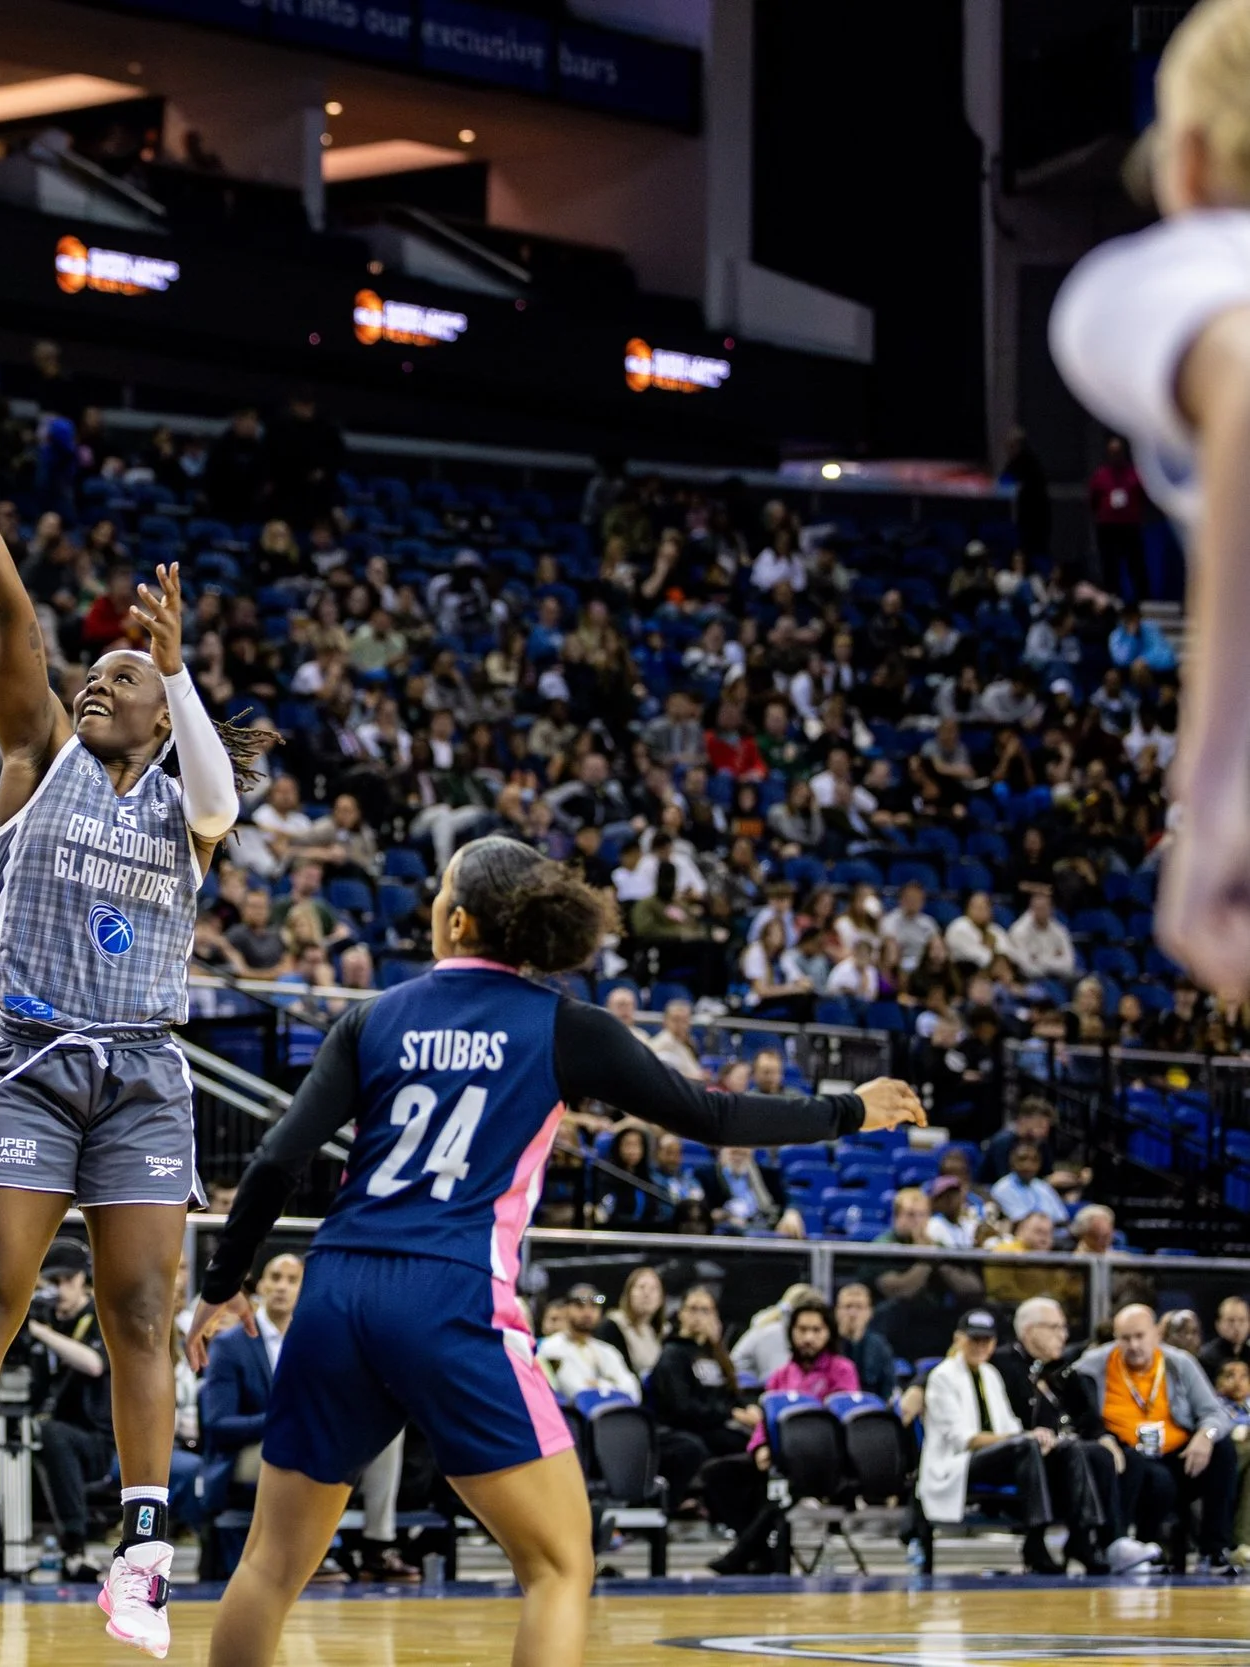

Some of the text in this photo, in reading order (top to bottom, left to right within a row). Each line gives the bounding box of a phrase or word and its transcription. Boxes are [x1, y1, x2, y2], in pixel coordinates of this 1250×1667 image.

[557, 39, 618, 84] bars
[65, 813, 177, 870] CALEDONIA
[53, 846, 180, 906] GLADIATORS
[399, 1029, 509, 1071] STUBBS
[145, 1155, 184, 1168] Reebok
[366, 1083, 488, 1201] 24
